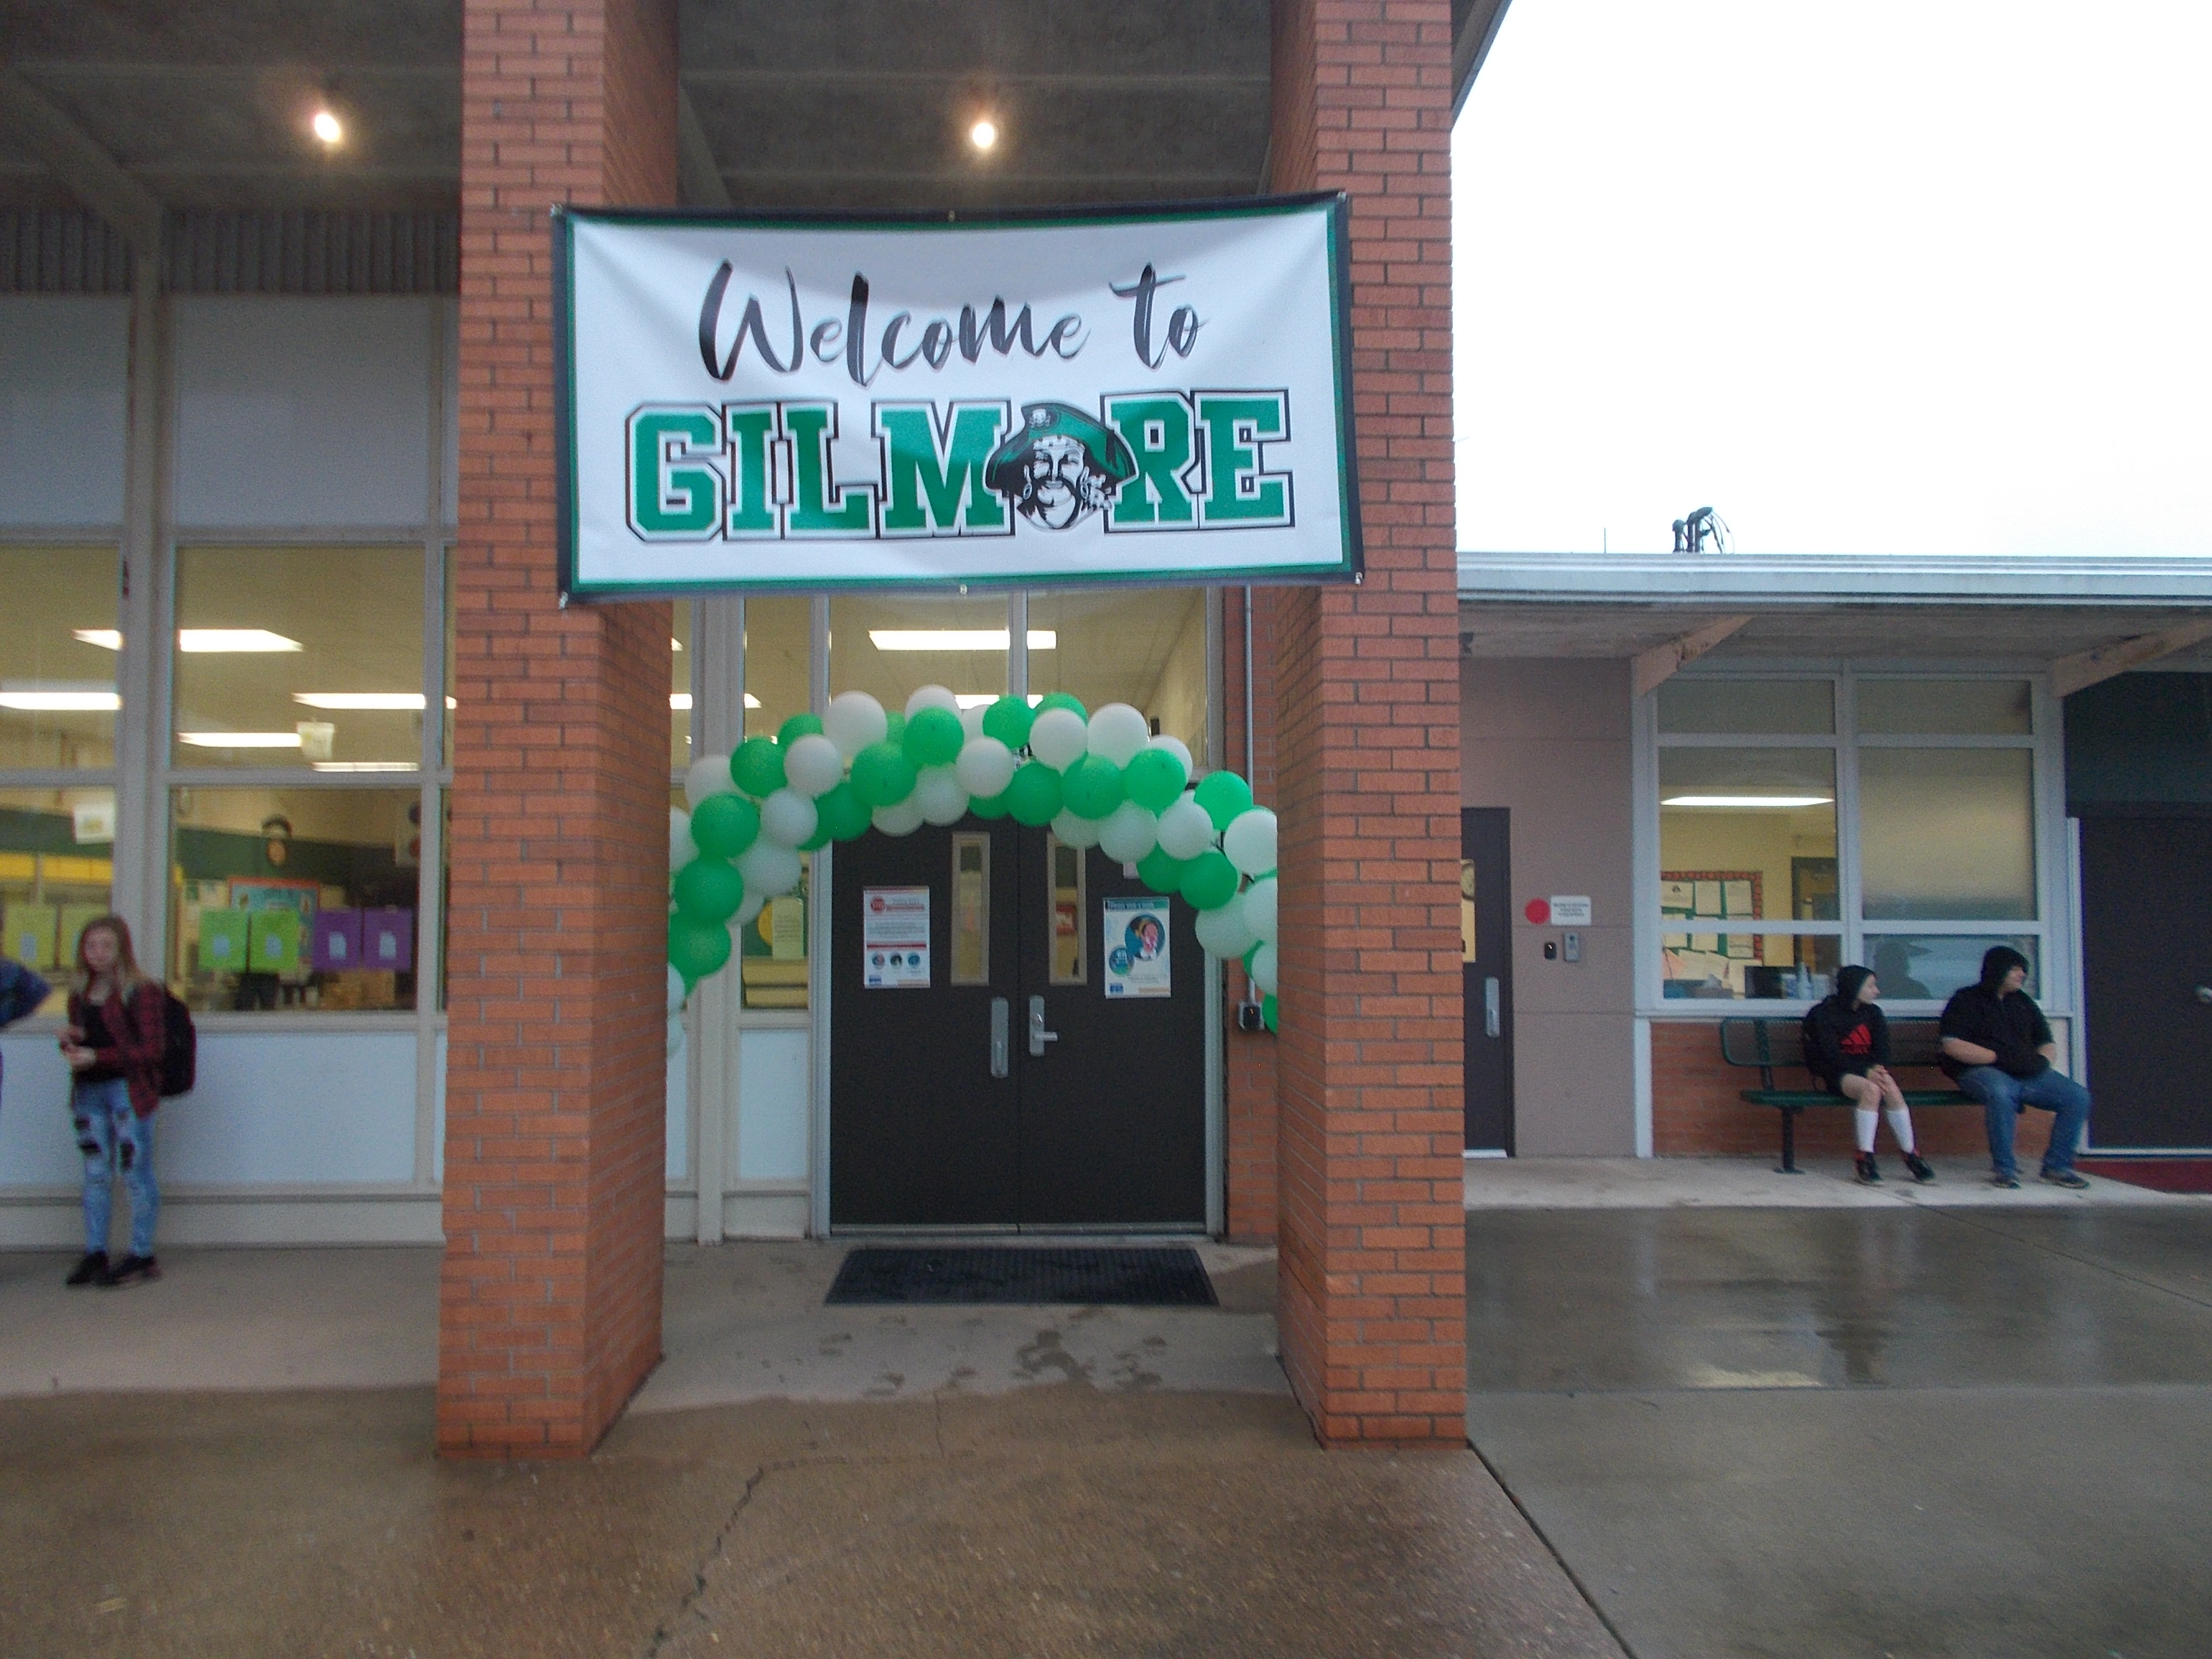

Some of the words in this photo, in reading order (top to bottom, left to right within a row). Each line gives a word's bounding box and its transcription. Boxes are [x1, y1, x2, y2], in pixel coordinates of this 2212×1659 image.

[698, 258, 1091, 387] Welcome
[1109, 261, 1208, 370] to
[625, 388, 1297, 543] GILMRE
